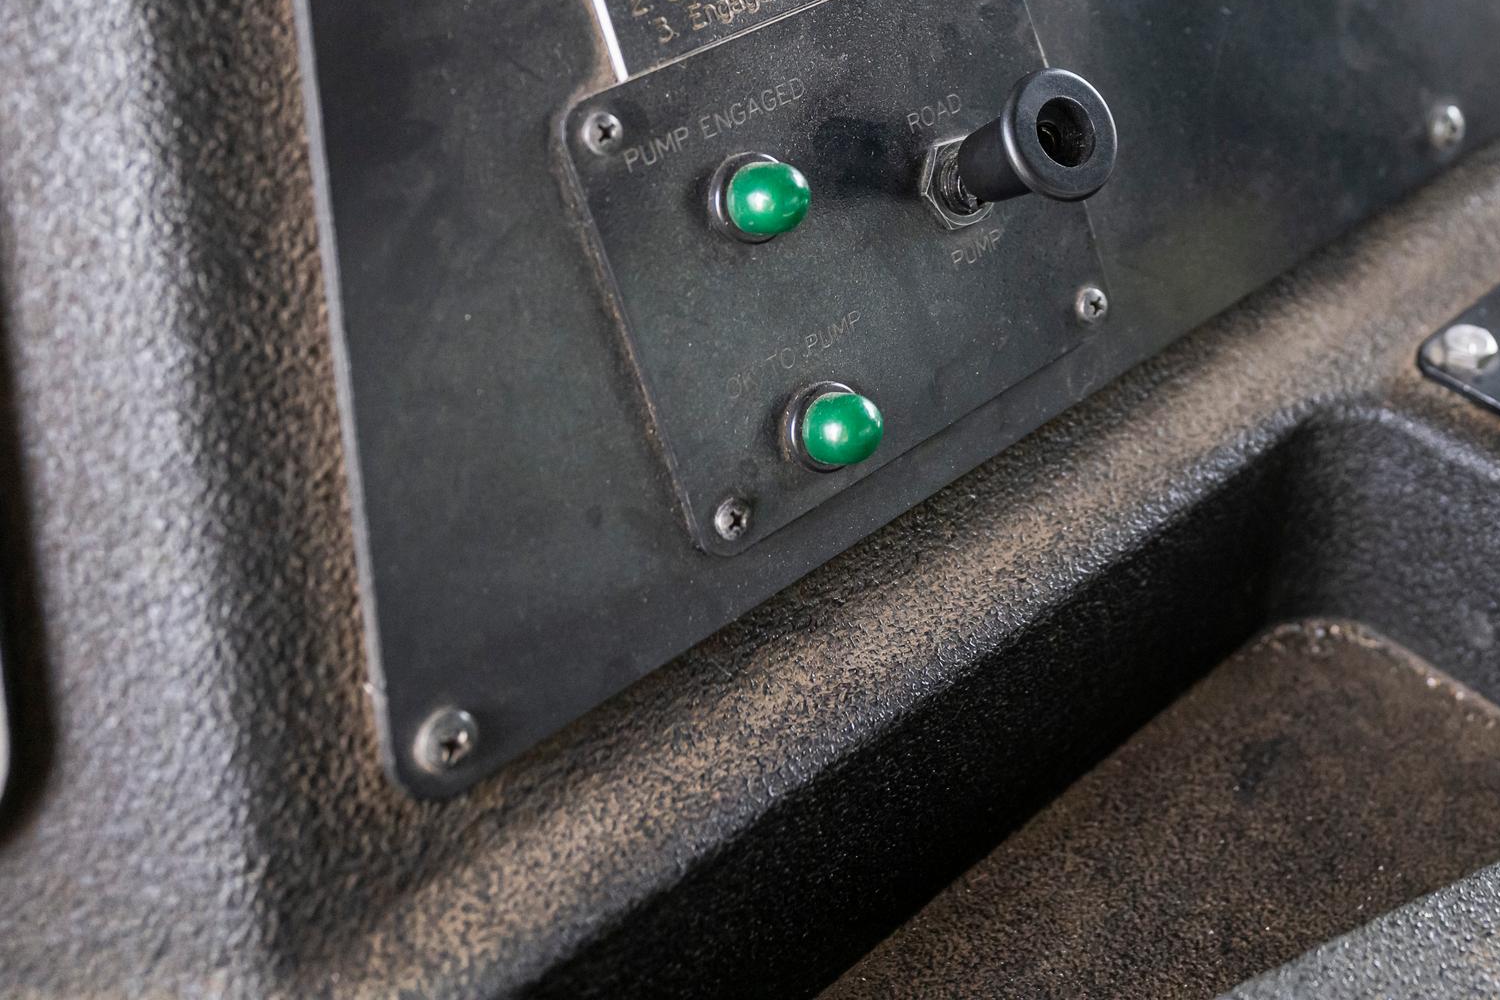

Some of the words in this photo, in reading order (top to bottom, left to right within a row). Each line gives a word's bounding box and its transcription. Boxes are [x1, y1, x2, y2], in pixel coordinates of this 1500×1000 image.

[655, 16, 680, 44] 3.
[623, 126, 690, 173] PUMP
[701, 76, 806, 140] ENGAGED
[905, 93, 963, 134] ROAD
[950, 228, 1002, 265] PUMP
[765, 347, 796, 375] TO
[805, 310, 861, 354] PUMP
